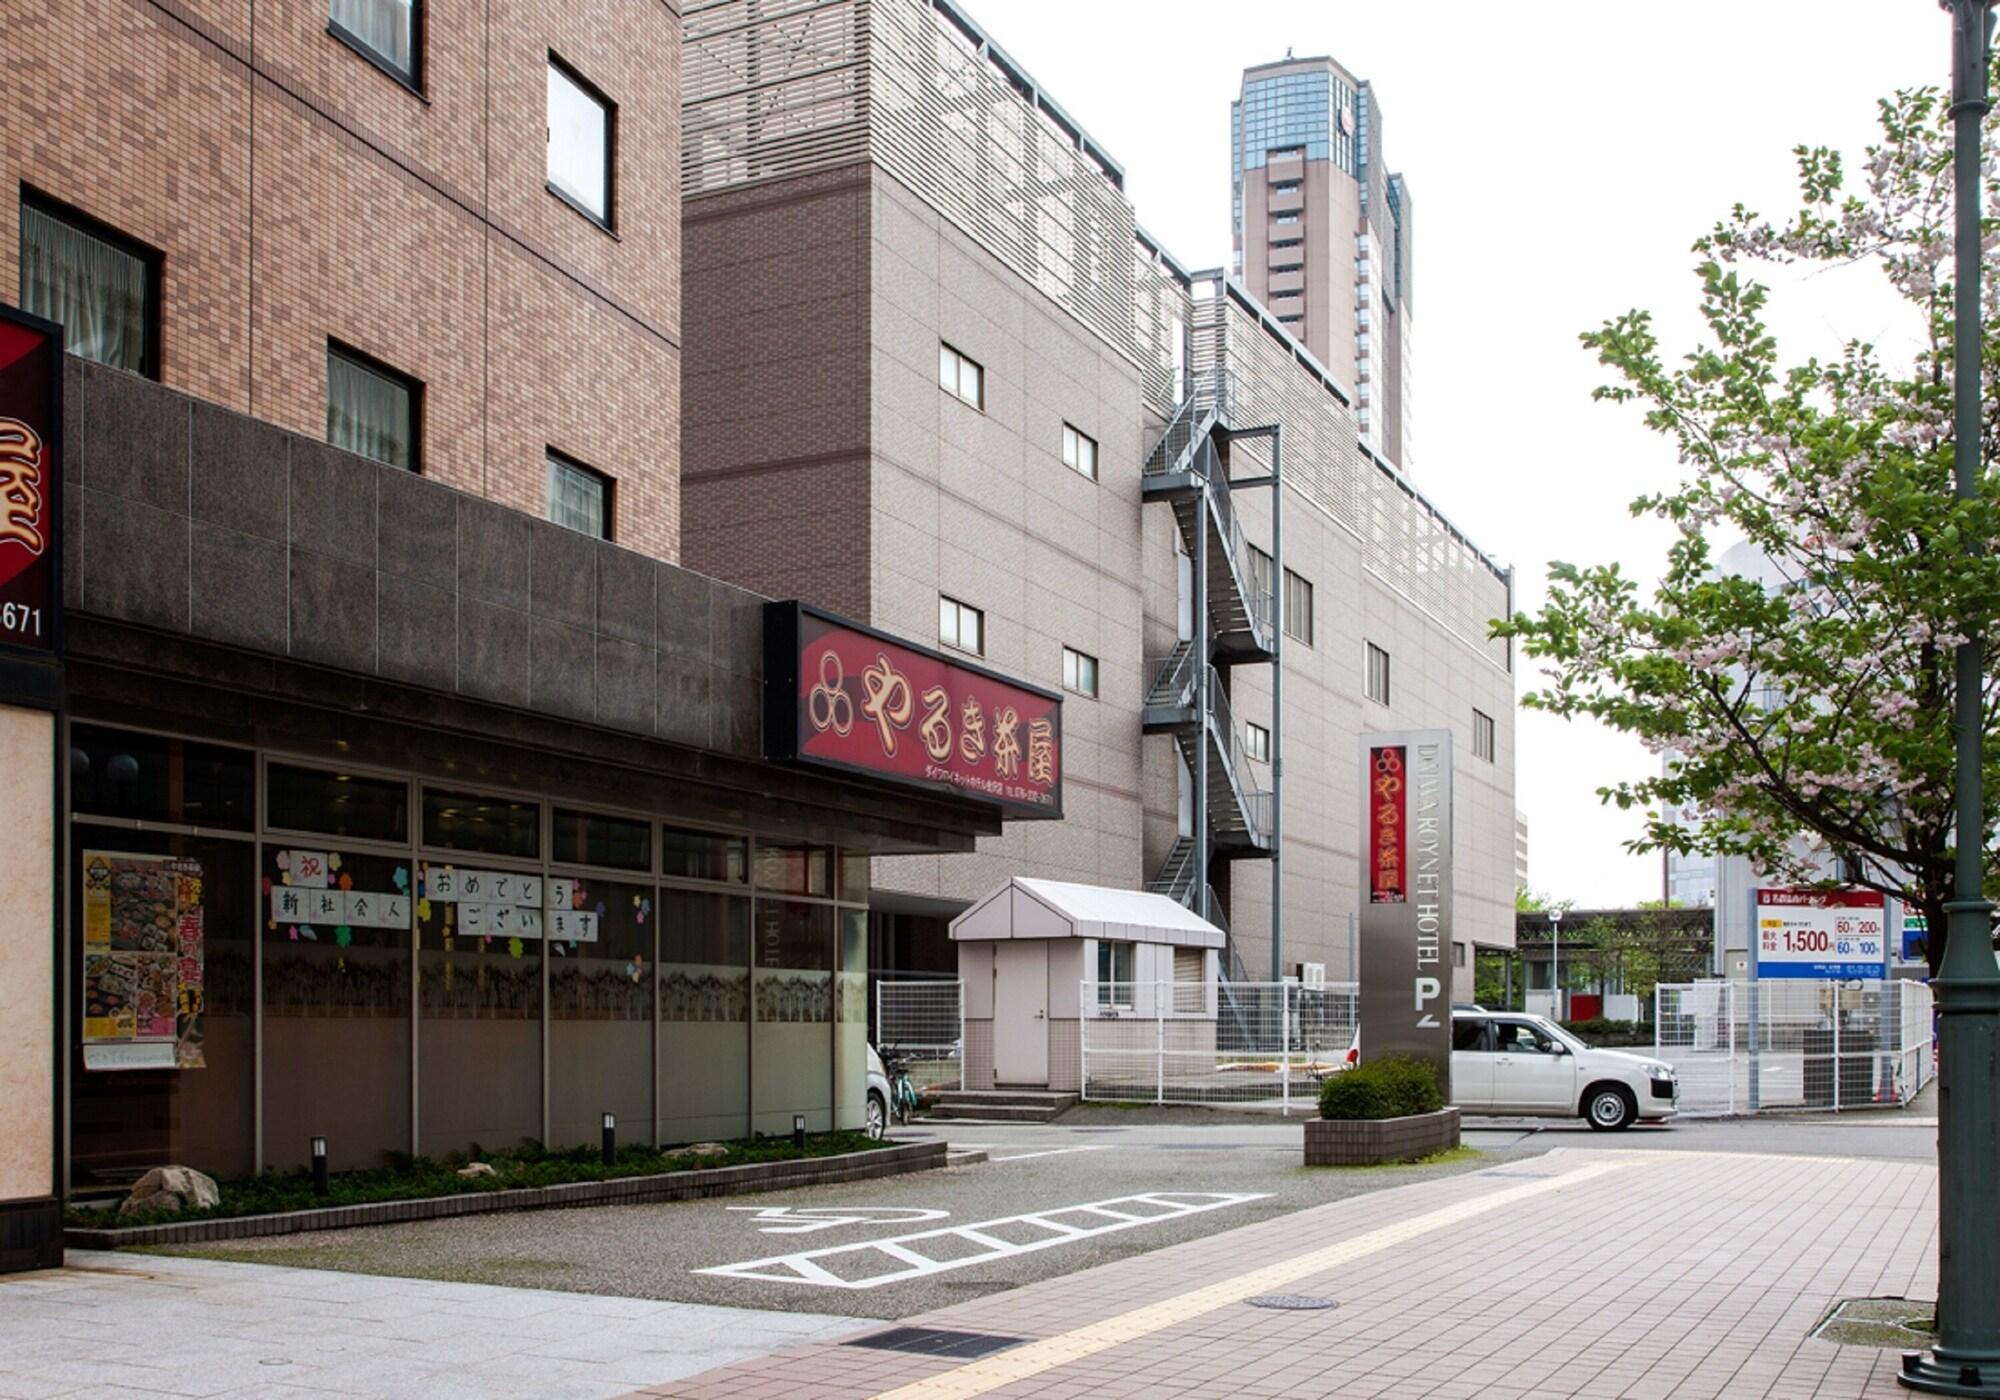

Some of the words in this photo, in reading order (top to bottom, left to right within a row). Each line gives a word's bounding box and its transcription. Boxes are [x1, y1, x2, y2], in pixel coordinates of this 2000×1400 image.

[0, 601, 40, 637] 671
[864, 653, 1053, 784] やるき茶屋
[1417, 744, 1439, 815] DAIWA
[1376, 775, 1401, 889] やるき茶屋
[300, 855, 322, 878] 祝
[1417, 817, 1439, 895] ROYNET
[282, 891, 401, 918] 新社会人
[436, 872, 566, 906] おめでとう
[468, 907, 592, 938] ございます
[1417, 904, 1439, 971] HOTEL
[1415, 976, 1442, 1012] P
